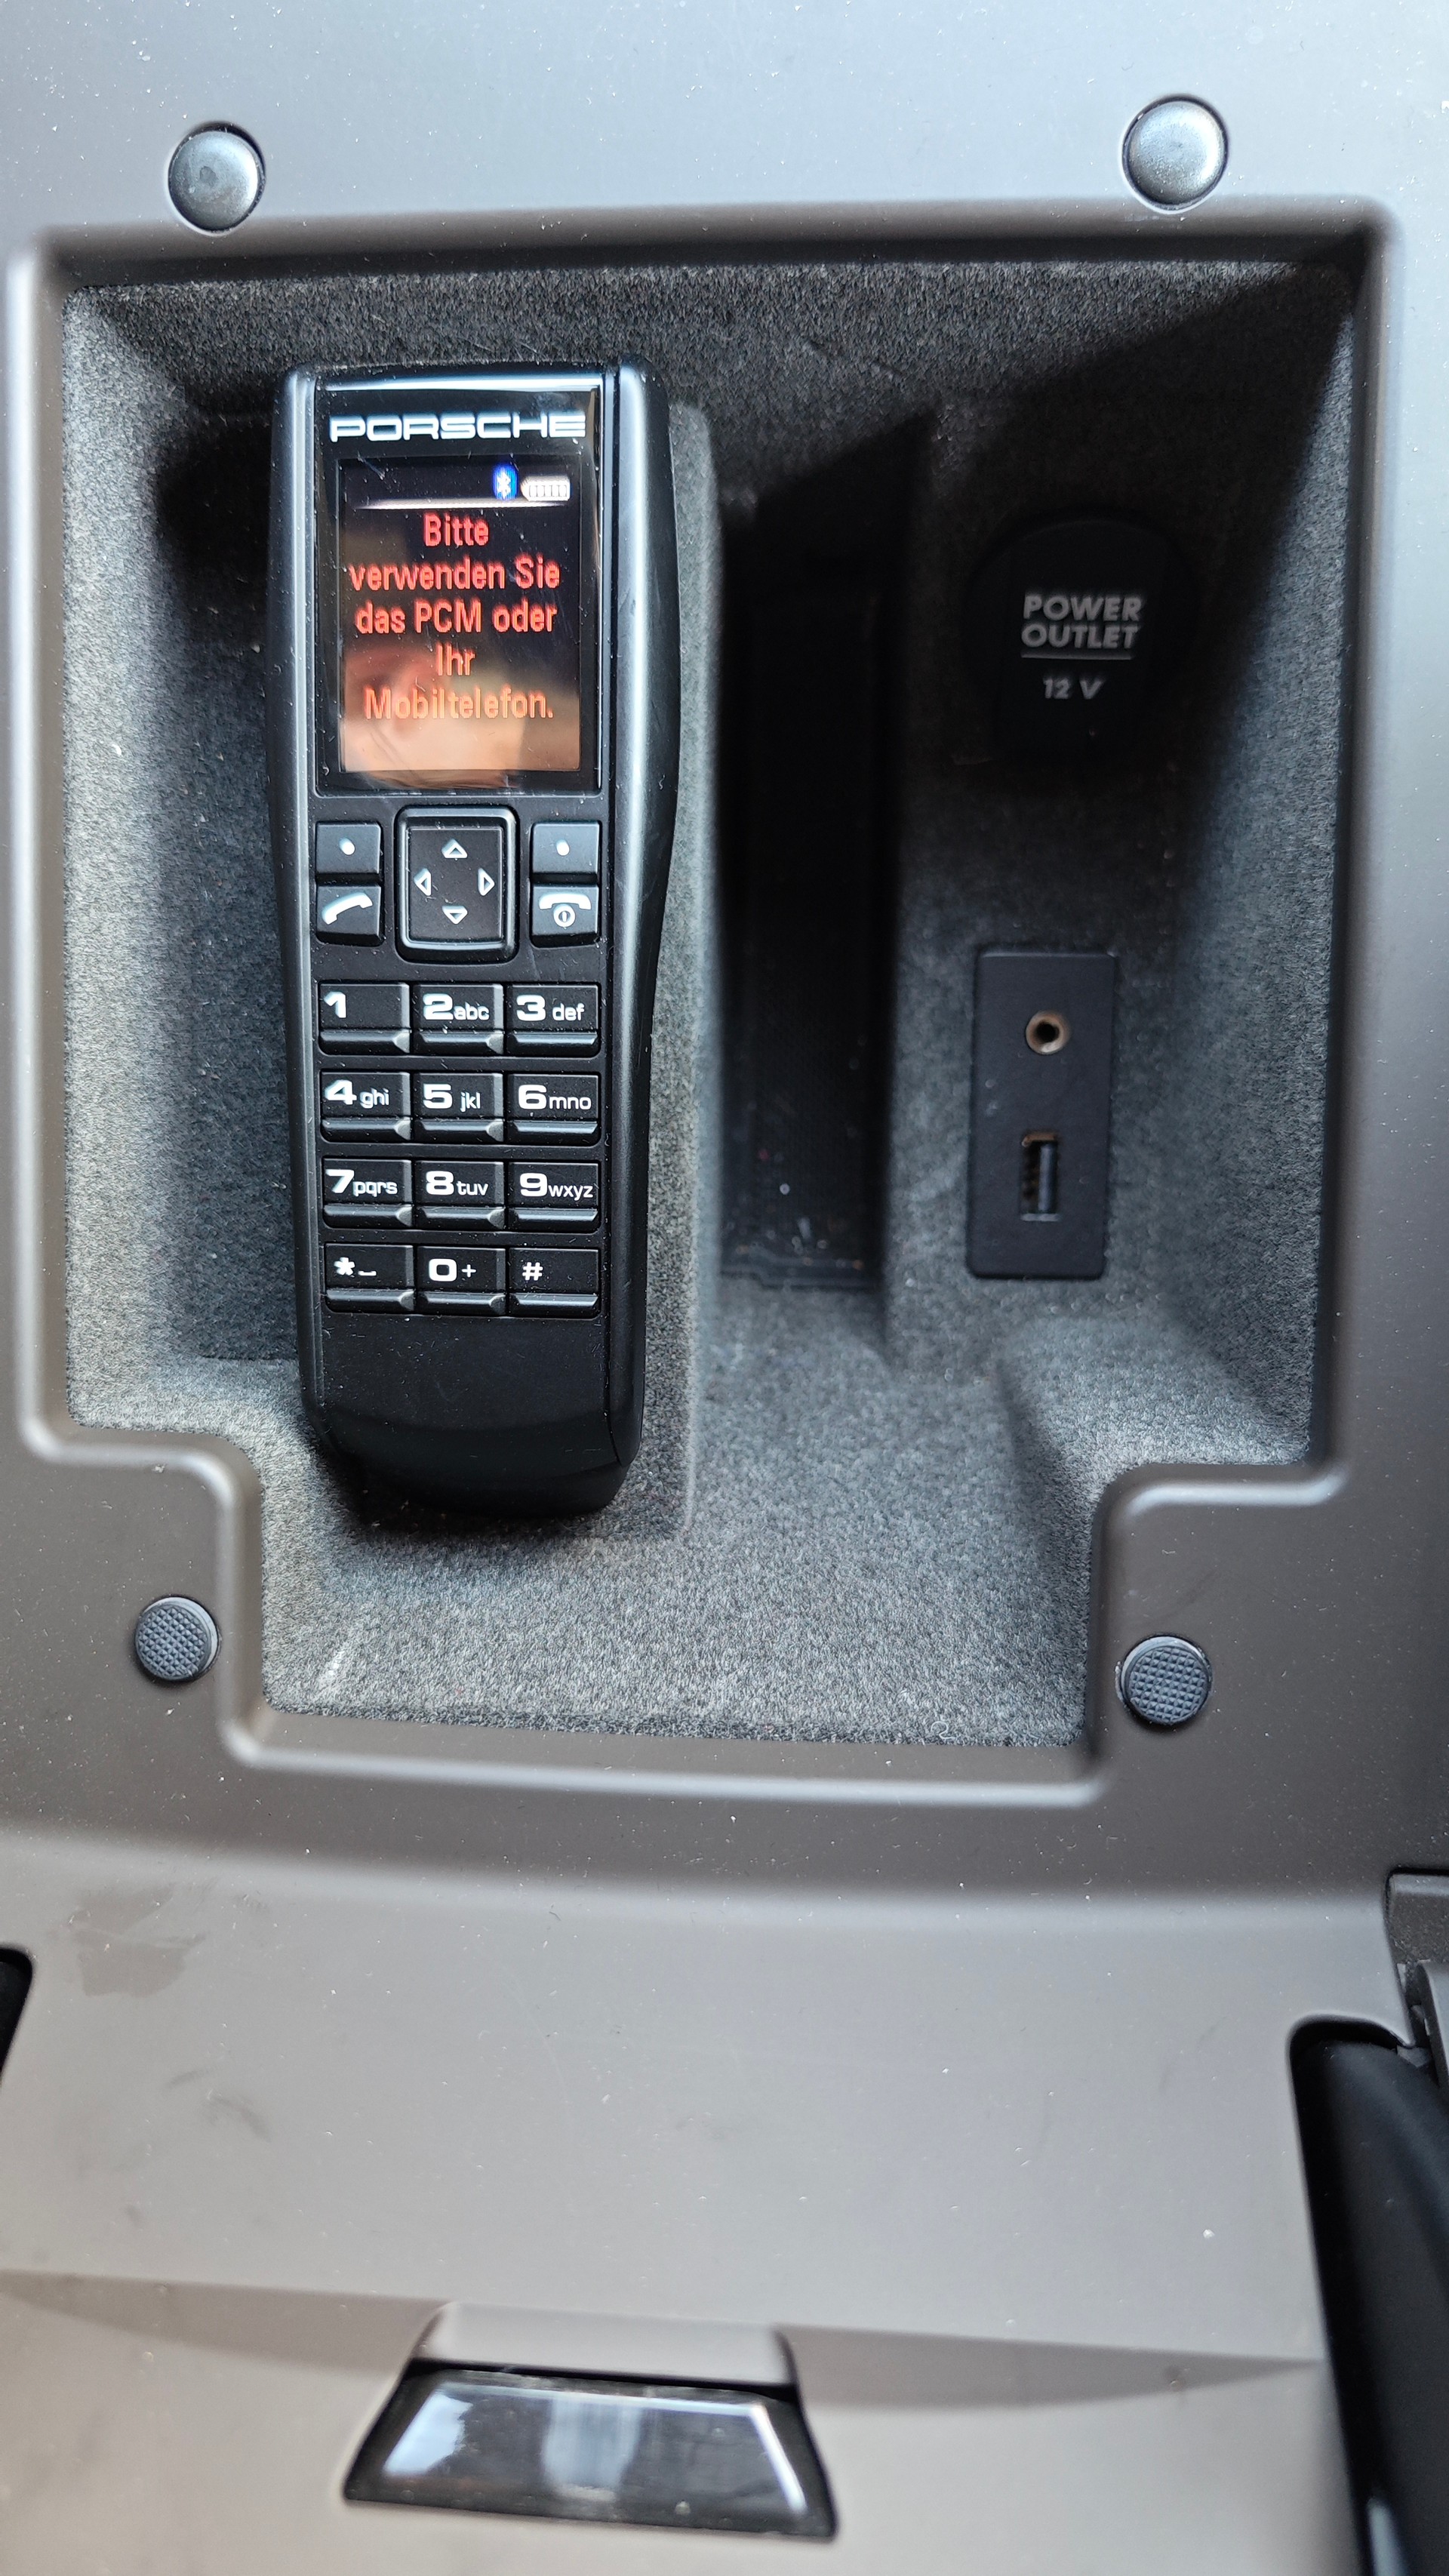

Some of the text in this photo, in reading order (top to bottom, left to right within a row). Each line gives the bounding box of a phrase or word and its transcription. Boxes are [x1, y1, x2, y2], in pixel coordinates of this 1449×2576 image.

[330, 410, 586, 442] PORSCHE
[424, 512, 488, 547] Bitte
[348, 554, 560, 591] verwenden Sie
[355, 598, 557, 633] das PCM oder
[1023, 594, 1142, 621] POWER
[1022, 623, 1139, 648] OUTLET
[435, 642, 475, 677] Ihr
[364, 686, 554, 719] Mobiltelefon.
[1044, 677, 1103, 699] 12 V
[324, 992, 346, 1017] 1
